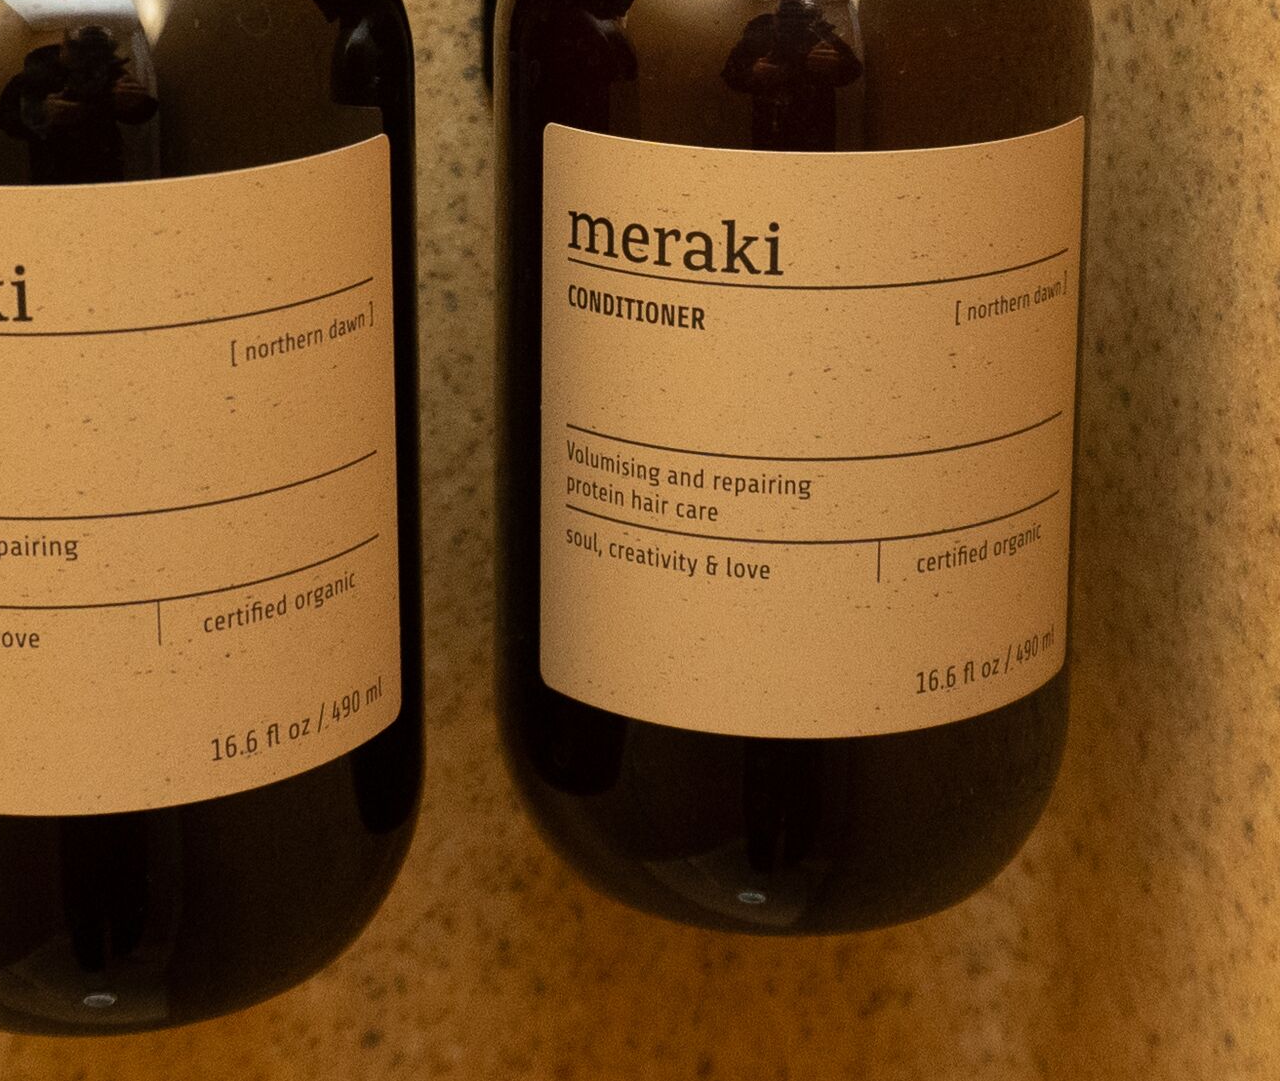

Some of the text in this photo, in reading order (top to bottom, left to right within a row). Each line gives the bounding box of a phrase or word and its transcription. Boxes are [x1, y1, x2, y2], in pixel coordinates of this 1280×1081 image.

[568, 210, 784, 276] meraki
[568, 284, 706, 330] CONDITIONER
[967, 293, 1030, 321] northern
[1034, 285, 1061, 304] dawn
[245, 328, 323, 360] northern
[328, 313, 365, 339] dawn
[566, 440, 812, 500] Volumising and repairing
[566, 475, 718, 521] protein hair care
[566, 528, 770, 580] soul, creativity & love
[916, 522, 1042, 573] certified organic
[203, 571, 356, 633] certified organic
[916, 625, 1055, 694] 16.6 fl oz / 490 ml
[211, 676, 383, 761] 16.6 fl oz / 490 ml
